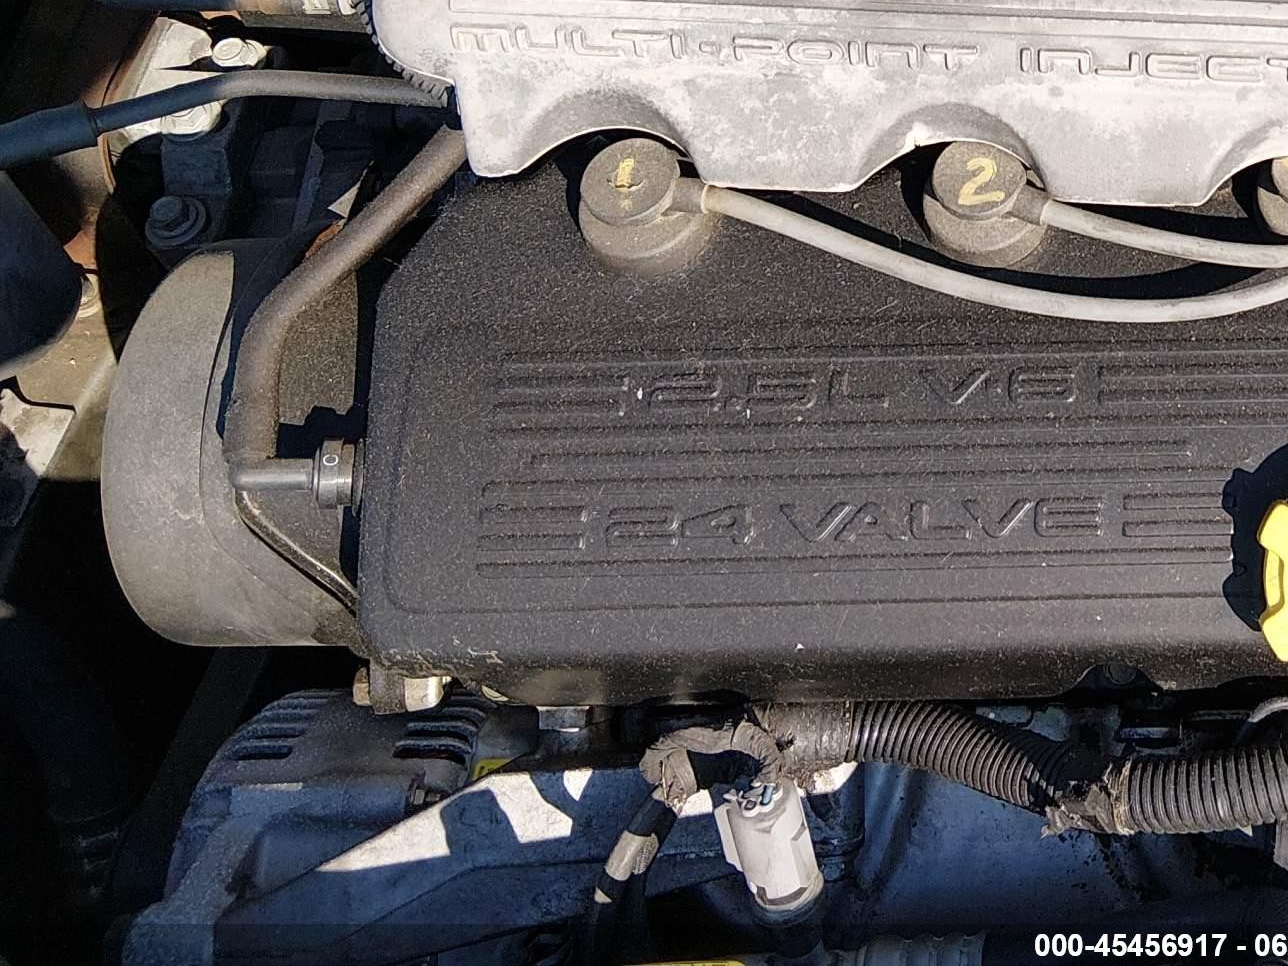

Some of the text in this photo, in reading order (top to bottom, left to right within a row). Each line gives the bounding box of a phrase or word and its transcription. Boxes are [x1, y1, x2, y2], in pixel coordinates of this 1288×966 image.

[957, 157, 1006, 207] 2
[920, 365, 1078, 406] V6
[604, 497, 1104, 547] 24 VALVE
